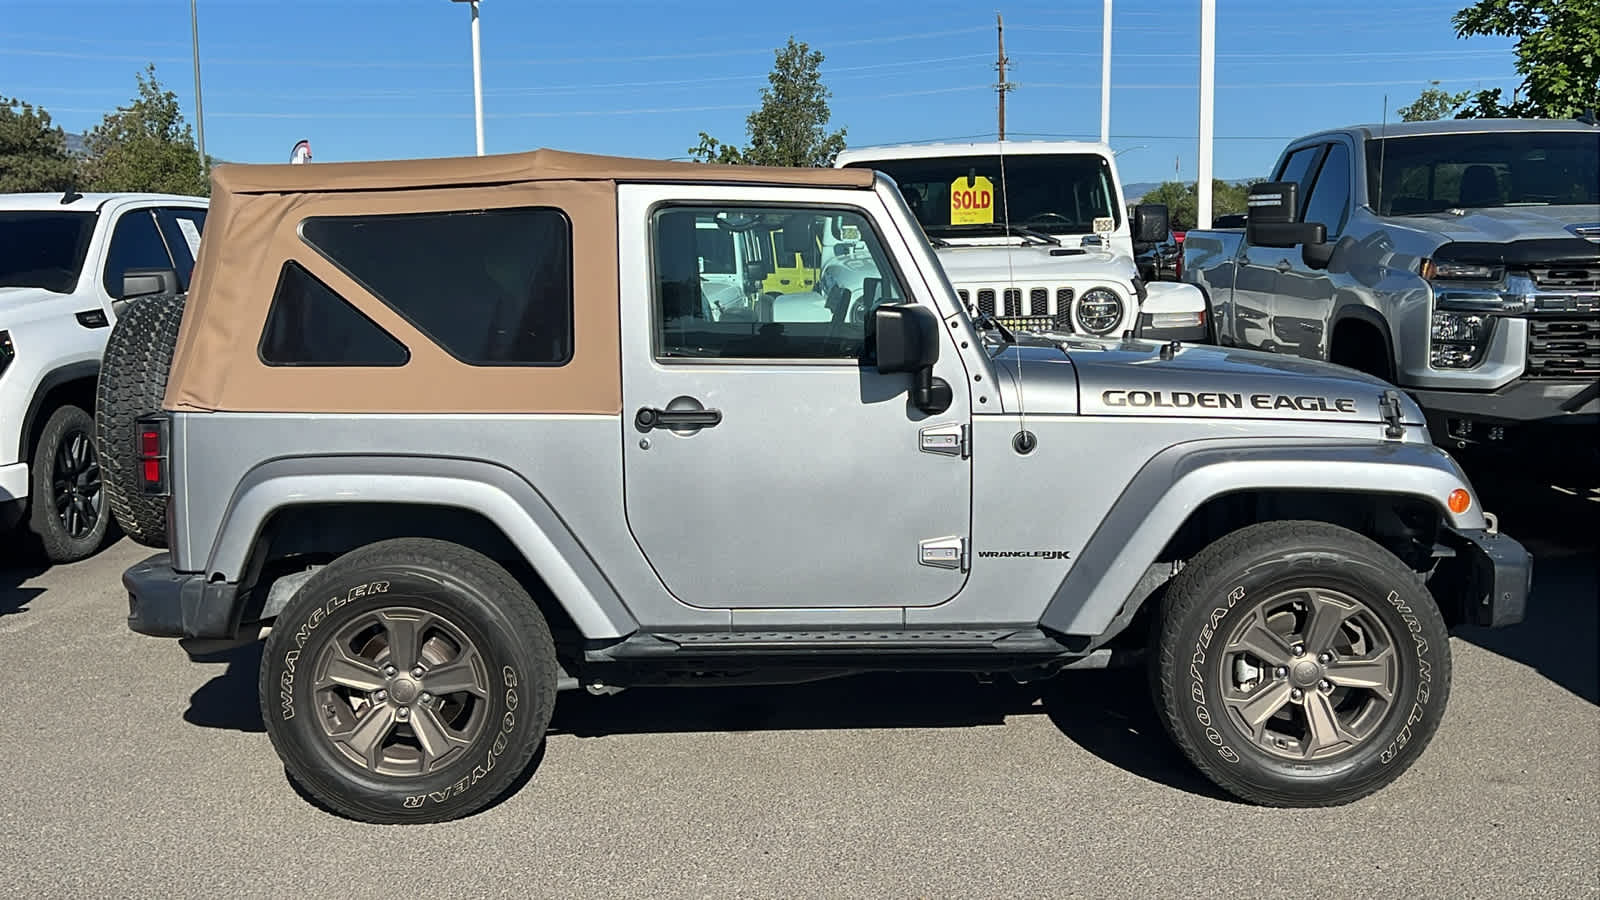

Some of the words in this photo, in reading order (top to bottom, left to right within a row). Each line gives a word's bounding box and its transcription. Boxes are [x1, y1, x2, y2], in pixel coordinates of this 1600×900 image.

[953, 190, 991, 209] SOLD
[1102, 390, 1243, 409] GOLDEN
[1250, 394, 1357, 413] EAGLE
[278, 580, 391, 721] WRANGLER
[1190, 585, 1246, 764] GOODYEAR
[1380, 590, 1432, 764] WRANGLER
[403, 664, 520, 809] GOODYEAR
